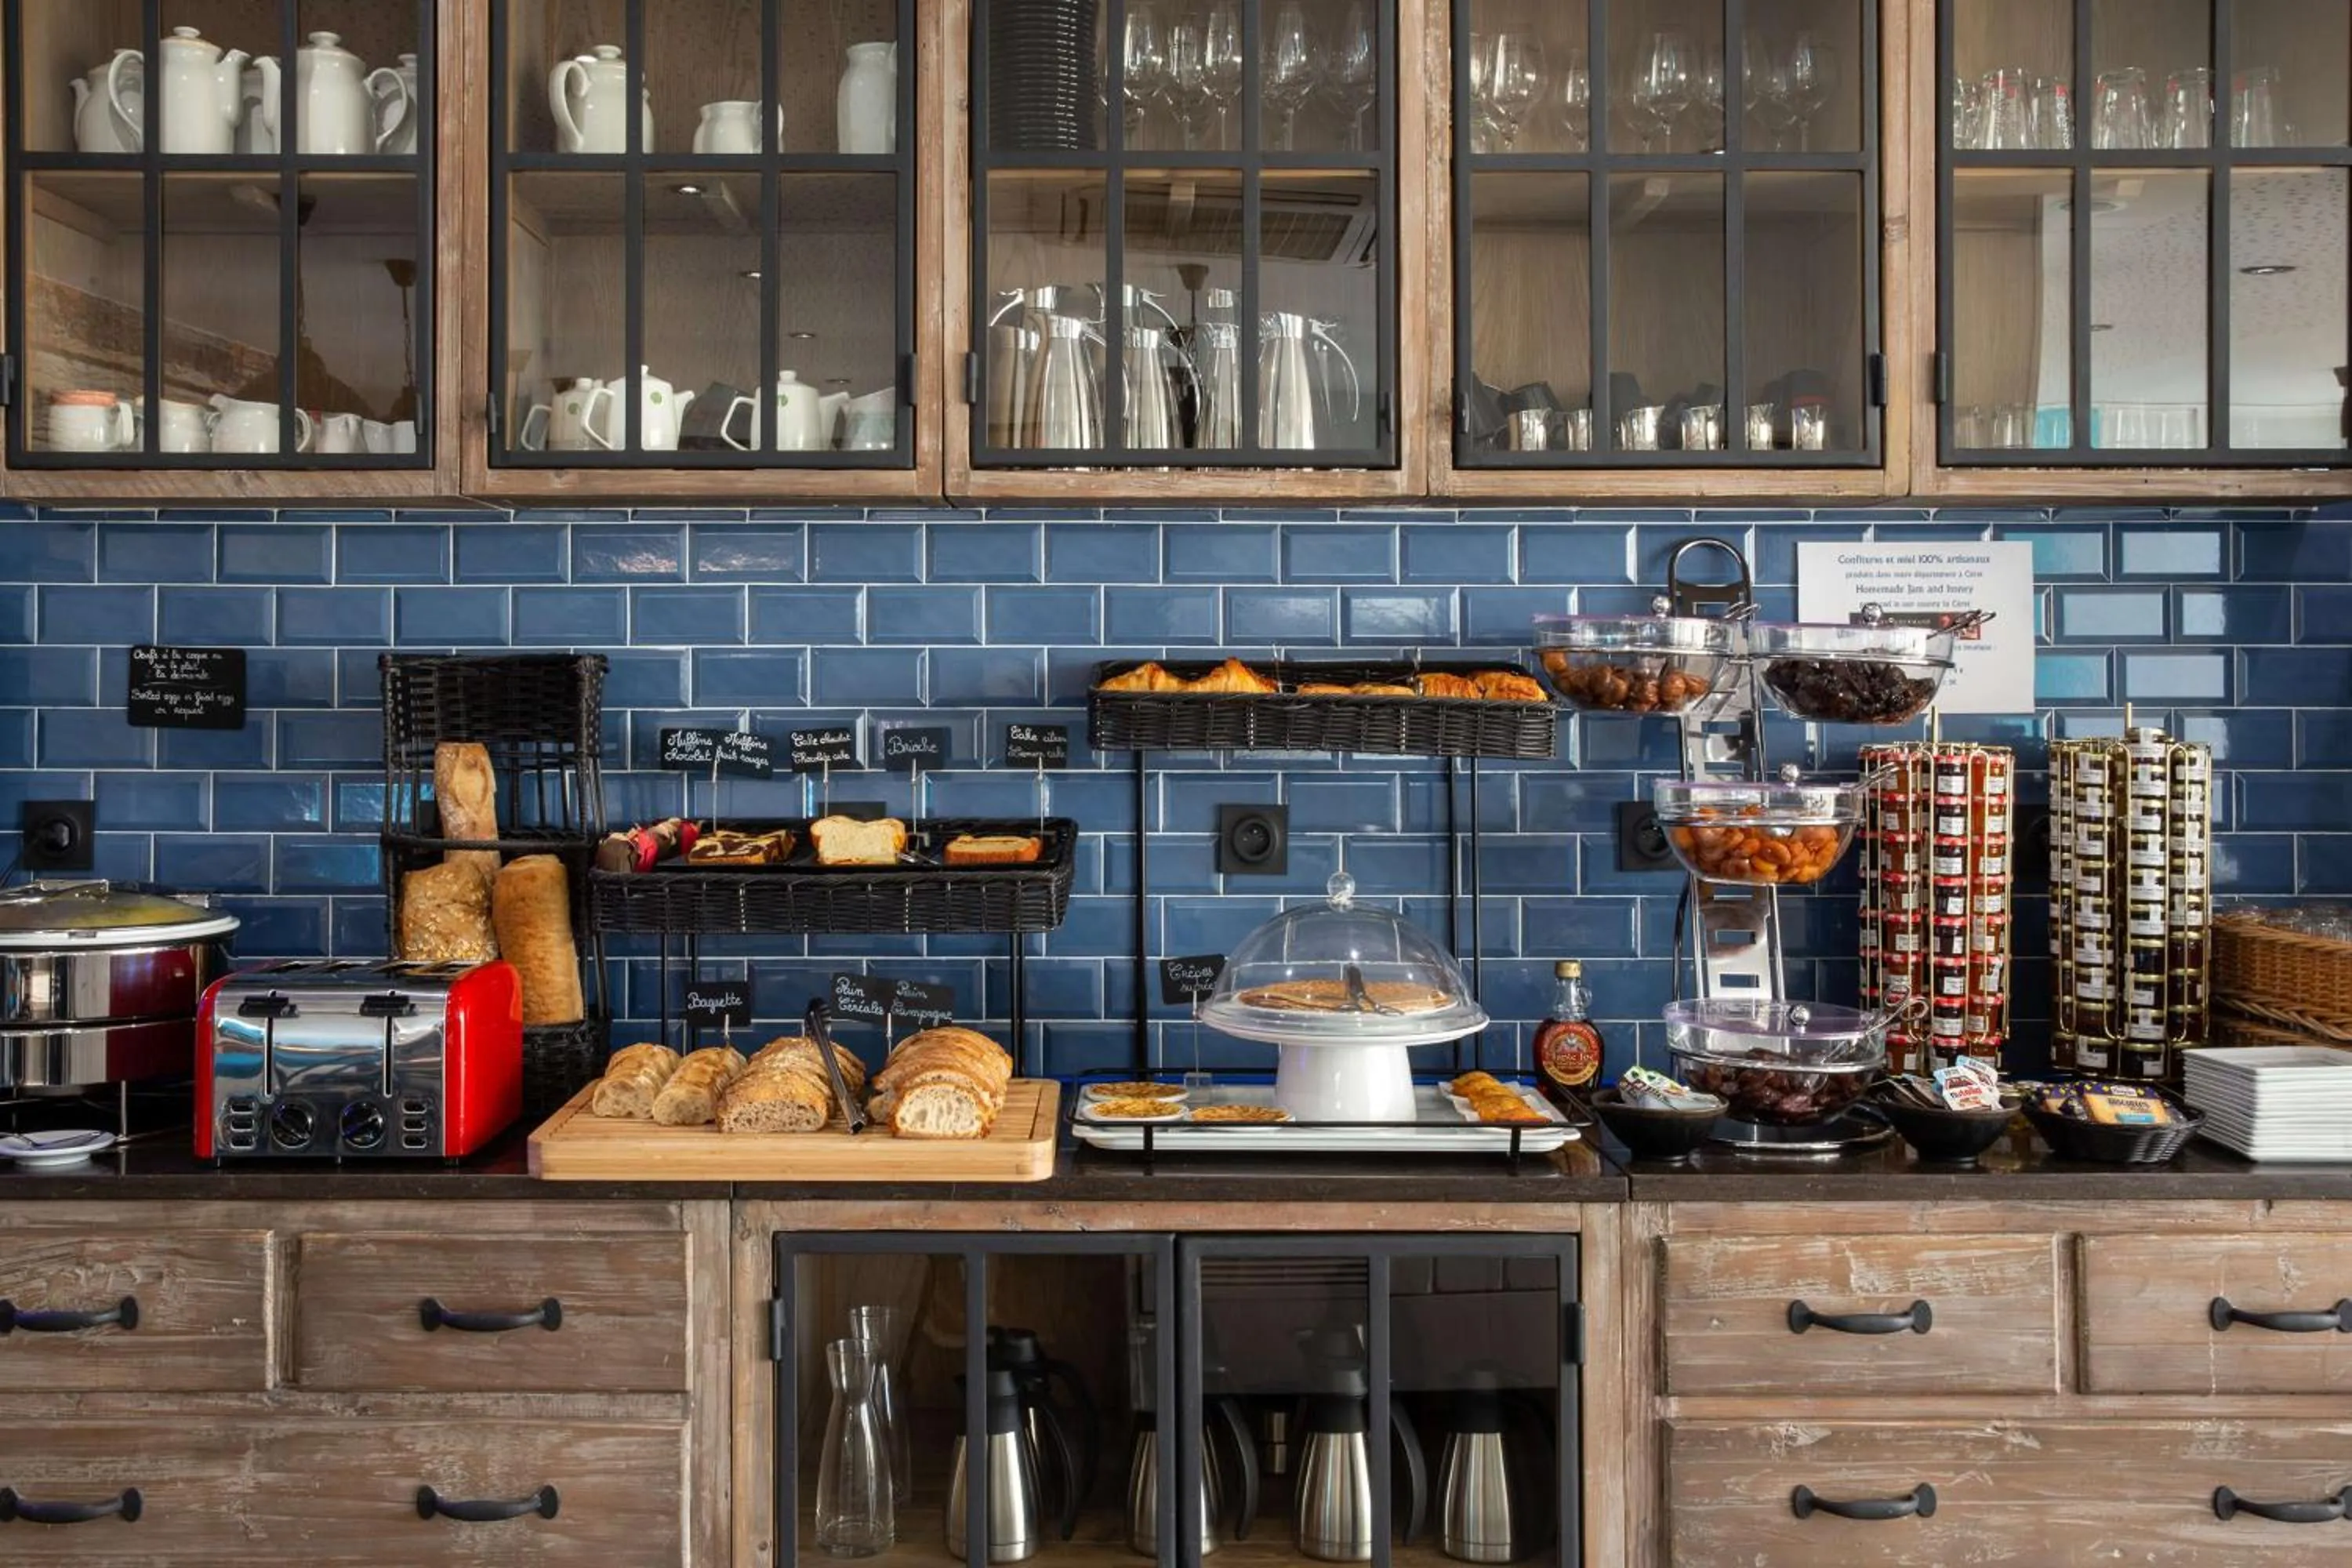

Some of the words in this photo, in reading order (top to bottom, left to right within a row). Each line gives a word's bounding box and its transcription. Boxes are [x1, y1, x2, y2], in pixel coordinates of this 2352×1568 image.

[1838, 554, 1882, 564] Confitures
[1918, 554, 1943, 564] 100%
[1856, 584, 1904, 593] Homemade
[667, 729, 713, 753] Muffins
[724, 731, 768, 752] Muffins
[791, 731, 819, 746] Cake
[887, 735, 938, 755] Brioche
[835, 976, 865, 997] Pain
[896, 980, 928, 999] Pain
[688, 992, 743, 1014] Baguette
